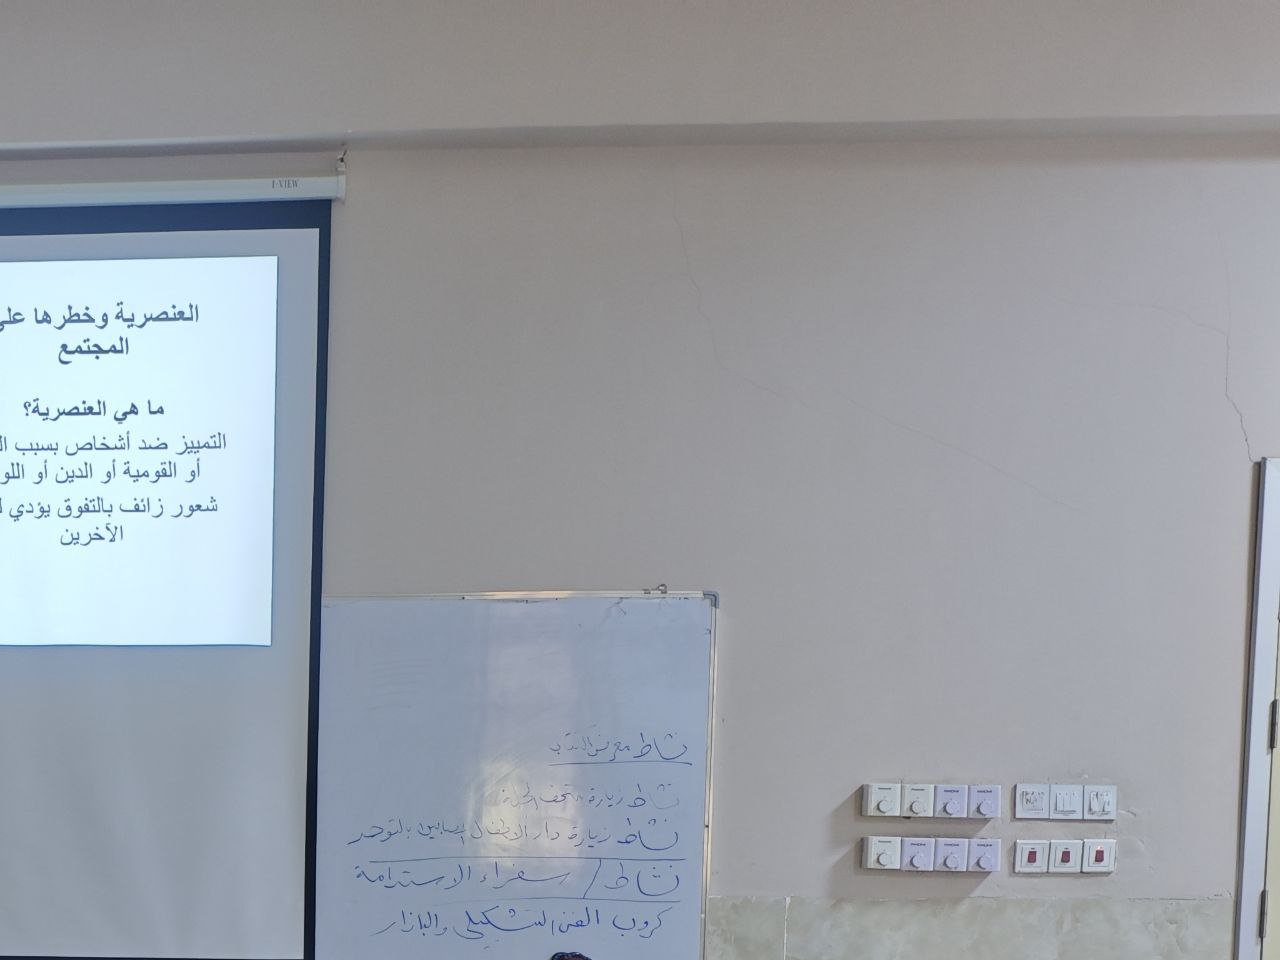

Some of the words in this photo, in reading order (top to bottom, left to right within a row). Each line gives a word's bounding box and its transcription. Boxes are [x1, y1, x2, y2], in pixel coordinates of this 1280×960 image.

[34, 306, 108, 329] وخطرها
[115, 302, 199, 329] العنصرية
[58, 337, 129, 364] المجتمع
[23, 399, 106, 421] العنصرية؟
[113, 402, 139, 424] هي
[147, 400, 165, 415] ما
[15, 439, 58, 455] بسبب
[65, 431, 130, 452] أشخاص
[138, 437, 168, 451] ضد
[177, 433, 226, 456] التمييز
[33, 461, 48, 485] أو
[55, 463, 92, 484] الدين
[100, 459, 116, 484] أو
[122, 462, 176, 482] القومية
[184, 460, 200, 483] أو
[9, 502, 50, 521] يؤدي
[57, 498, 113, 518] بالتفوق
[119, 497, 163, 517] زائف
[171, 496, 218, 519] شعور
[60, 523, 123, 545] الآخرين
